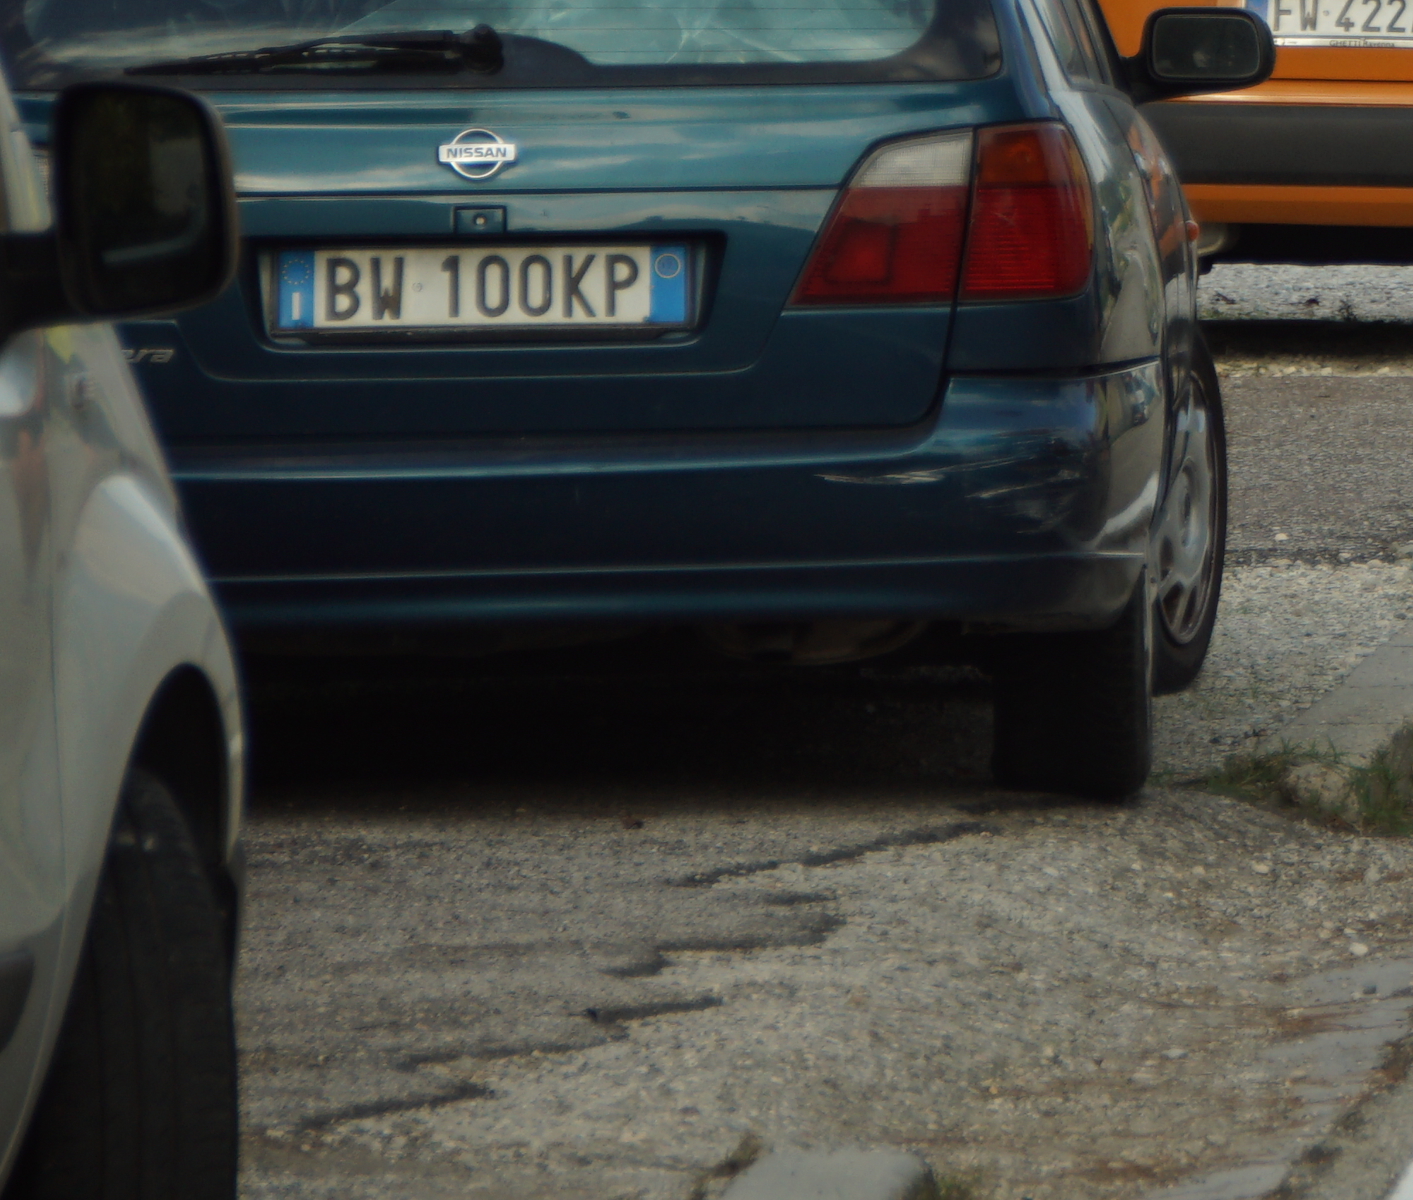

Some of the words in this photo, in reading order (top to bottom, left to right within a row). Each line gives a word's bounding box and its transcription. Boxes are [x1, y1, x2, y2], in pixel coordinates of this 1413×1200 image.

[446, 147, 508, 159] NISSAN
[324, 256, 405, 322] BW
[440, 253, 640, 319] 100KP
